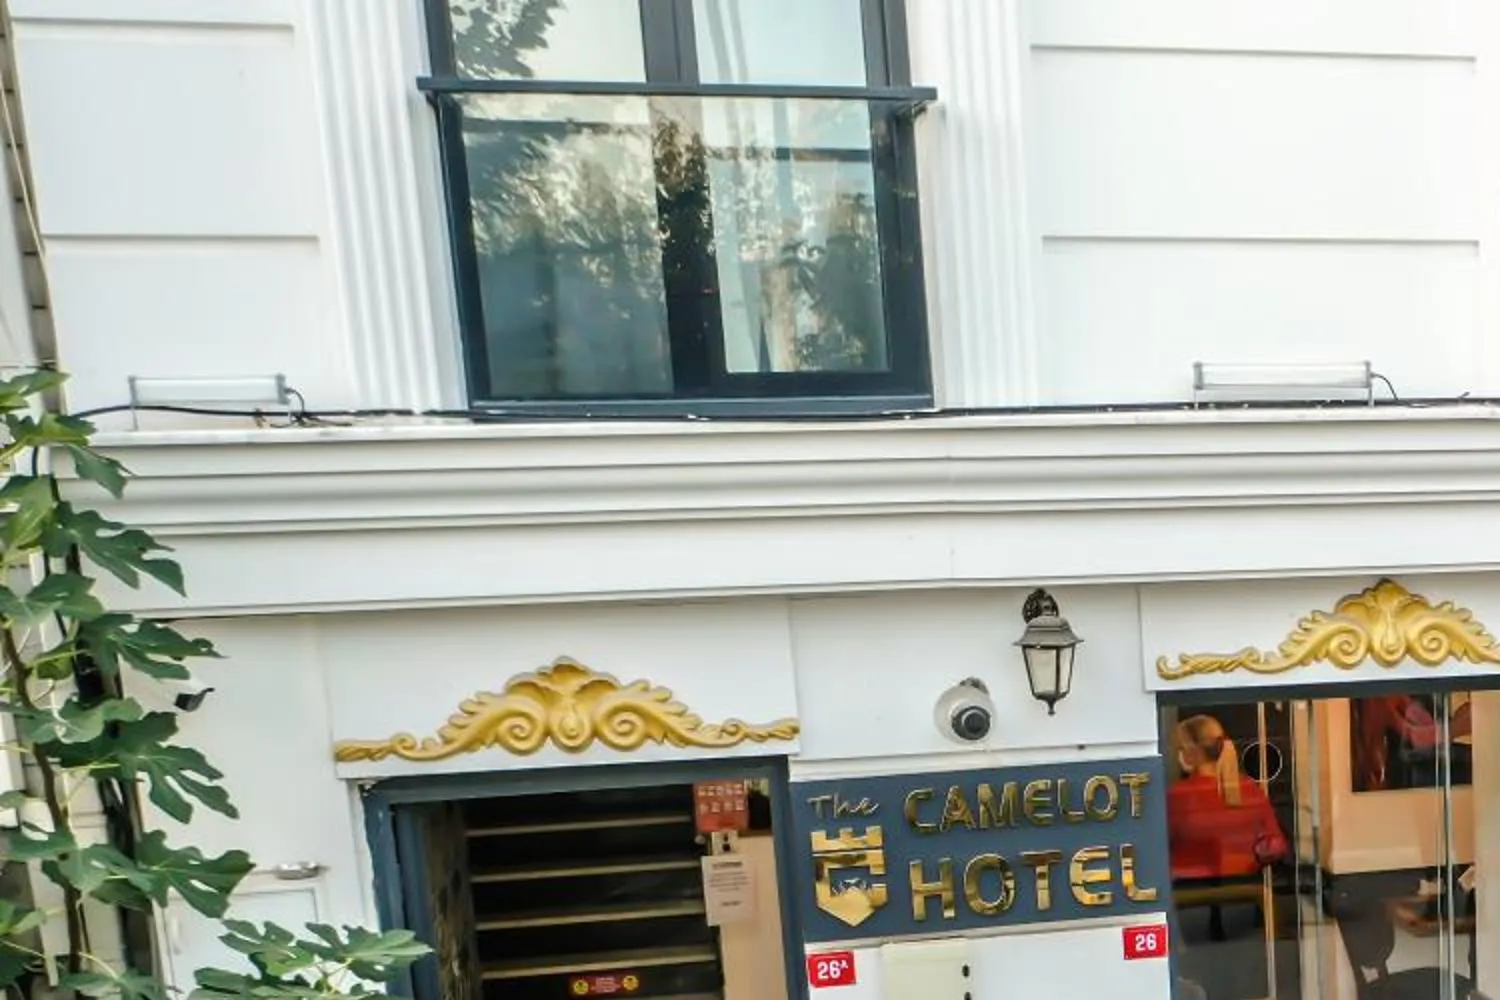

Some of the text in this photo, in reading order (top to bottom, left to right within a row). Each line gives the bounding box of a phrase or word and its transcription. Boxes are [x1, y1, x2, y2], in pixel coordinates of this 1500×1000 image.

[807, 771, 1150, 834] The CAMELOT
[909, 843, 1158, 921] HOTEL
[1135, 932, 1157, 951] 26
